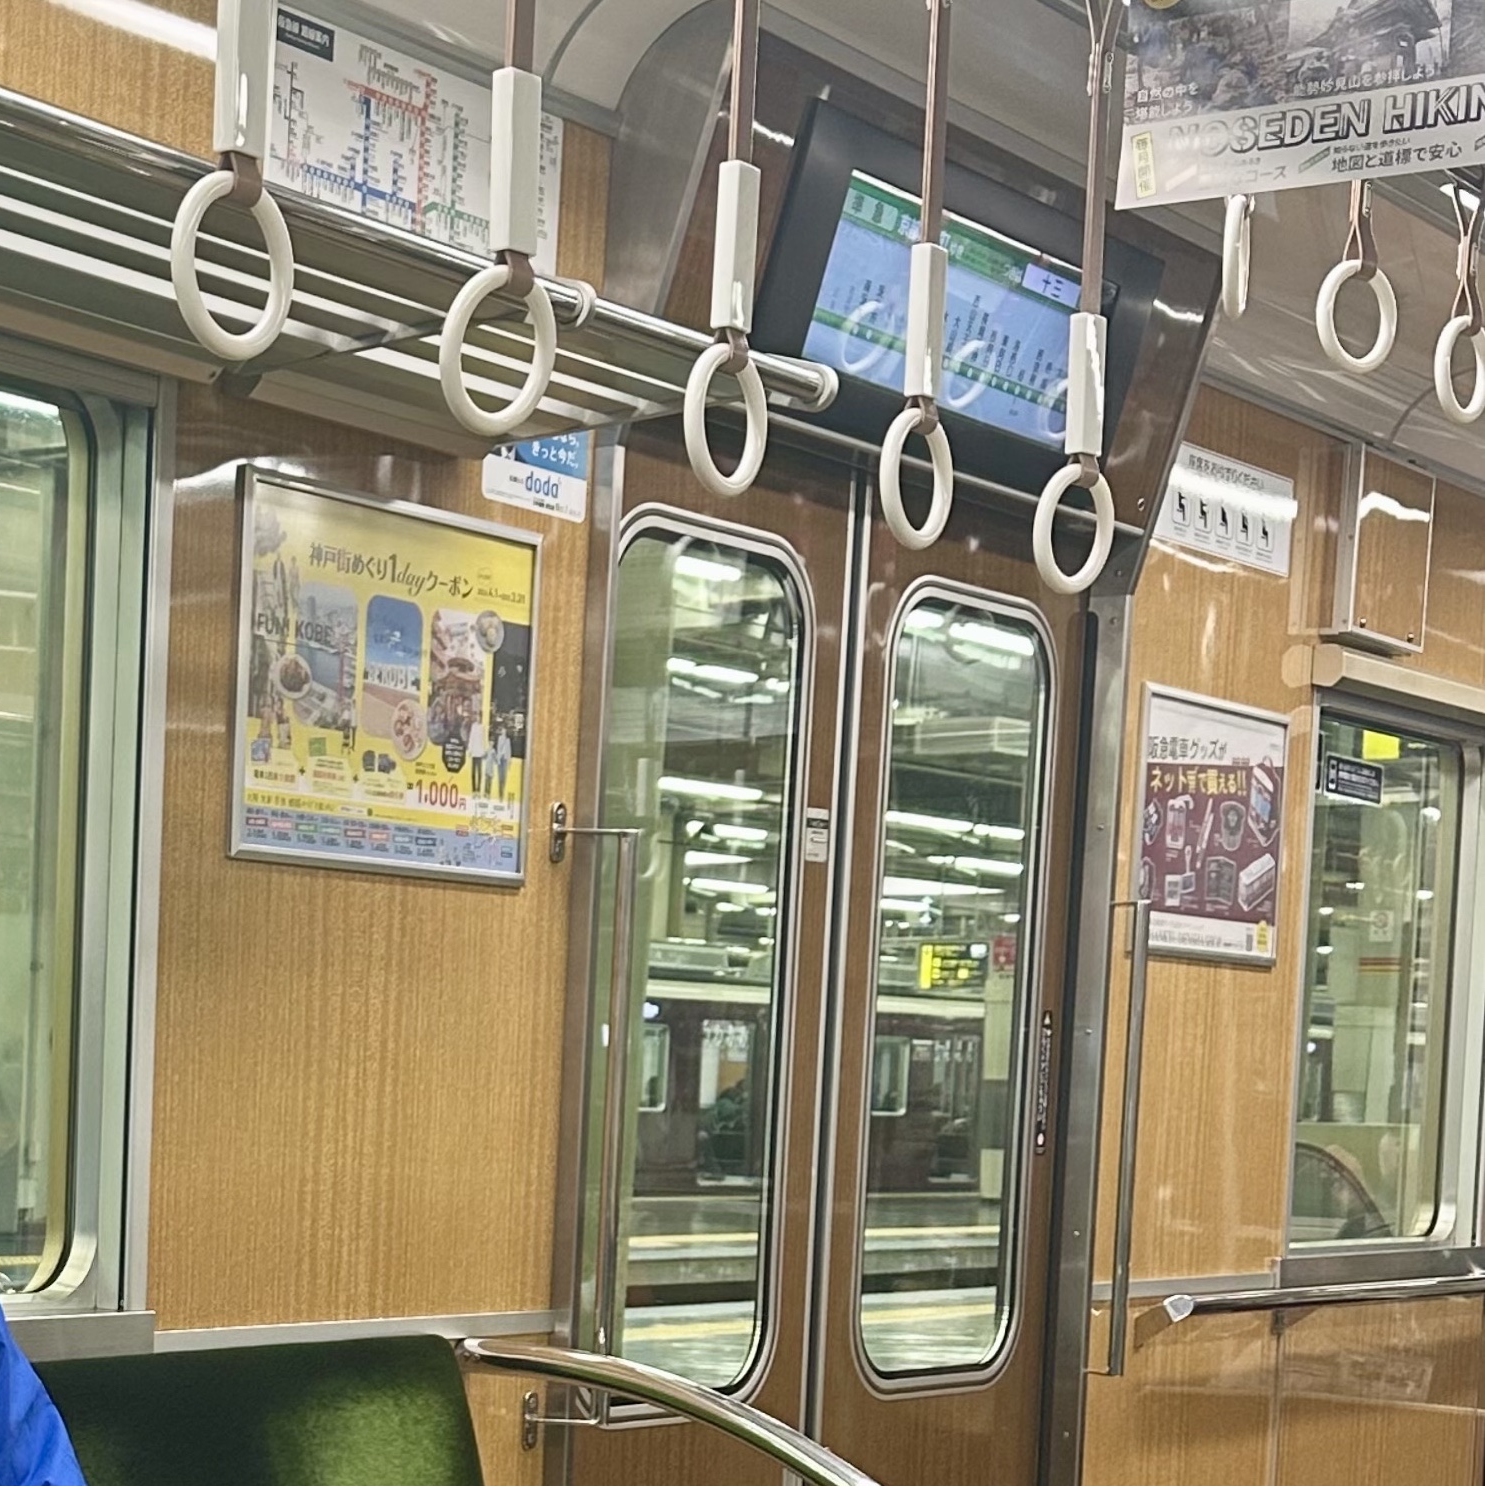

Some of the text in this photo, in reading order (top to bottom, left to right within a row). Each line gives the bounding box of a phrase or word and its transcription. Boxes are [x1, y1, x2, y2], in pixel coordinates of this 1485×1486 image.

[1167, 98, 1372, 158] NOSEDEN
[1331, 141, 1463, 173] 地図と道標で安心
[1042, 274, 1065, 299] 十三
[525, 470, 560, 499] doda
[309, 542, 474, 599] 神戸街めぐり1dayクーポン
